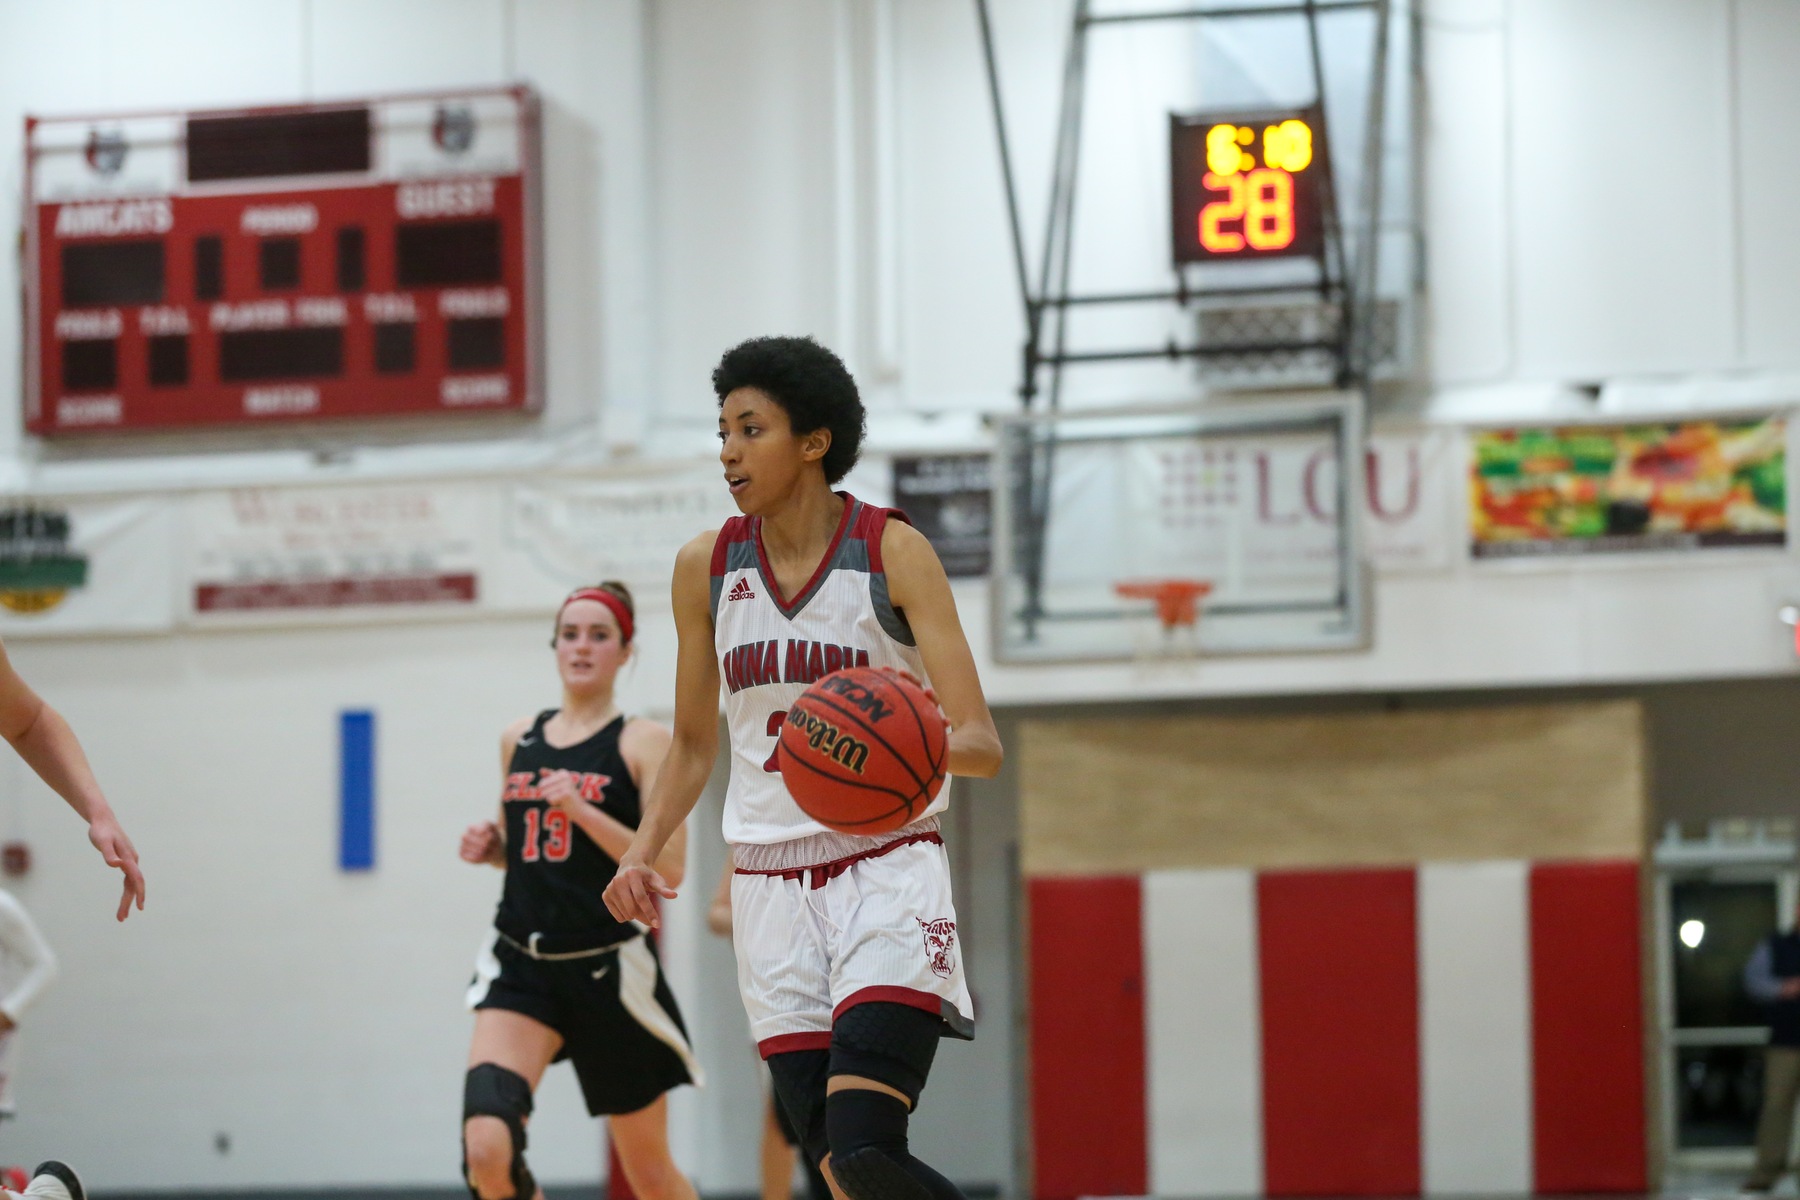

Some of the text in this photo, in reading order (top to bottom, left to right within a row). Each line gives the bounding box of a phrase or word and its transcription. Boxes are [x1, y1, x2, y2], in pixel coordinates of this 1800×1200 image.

[1198, 168, 1296, 253] 28
[728, 591, 755, 602] adidas
[786, 704, 870, 775] Wilson
[504, 768, 612, 802] CLK
[521, 808, 573, 862] 13
